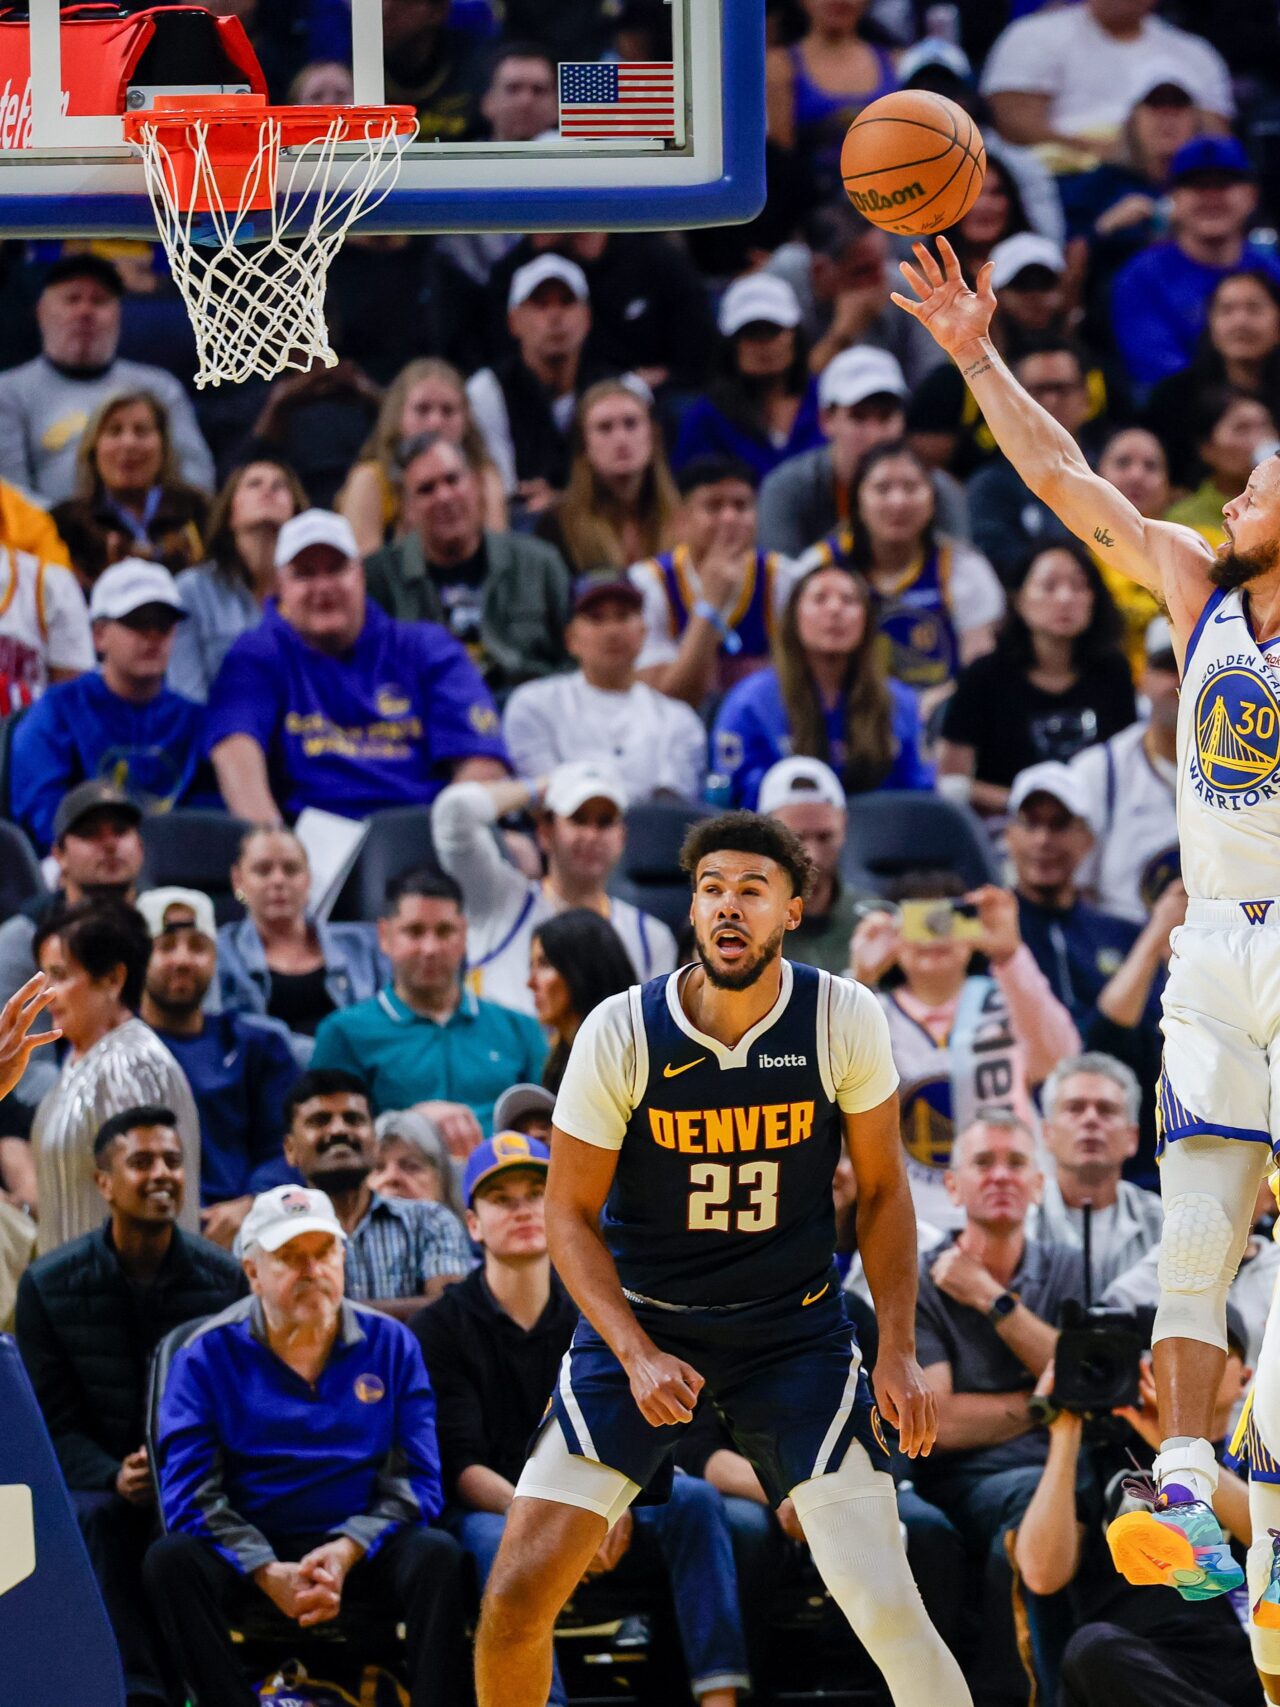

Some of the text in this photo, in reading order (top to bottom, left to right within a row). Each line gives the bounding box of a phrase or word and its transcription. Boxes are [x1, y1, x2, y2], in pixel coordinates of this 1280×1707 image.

[1235, 700, 1276, 740] 30
[758, 1053, 808, 1069] ibotta
[647, 1099, 816, 1154] DENVER
[686, 1160, 781, 1233] 23
